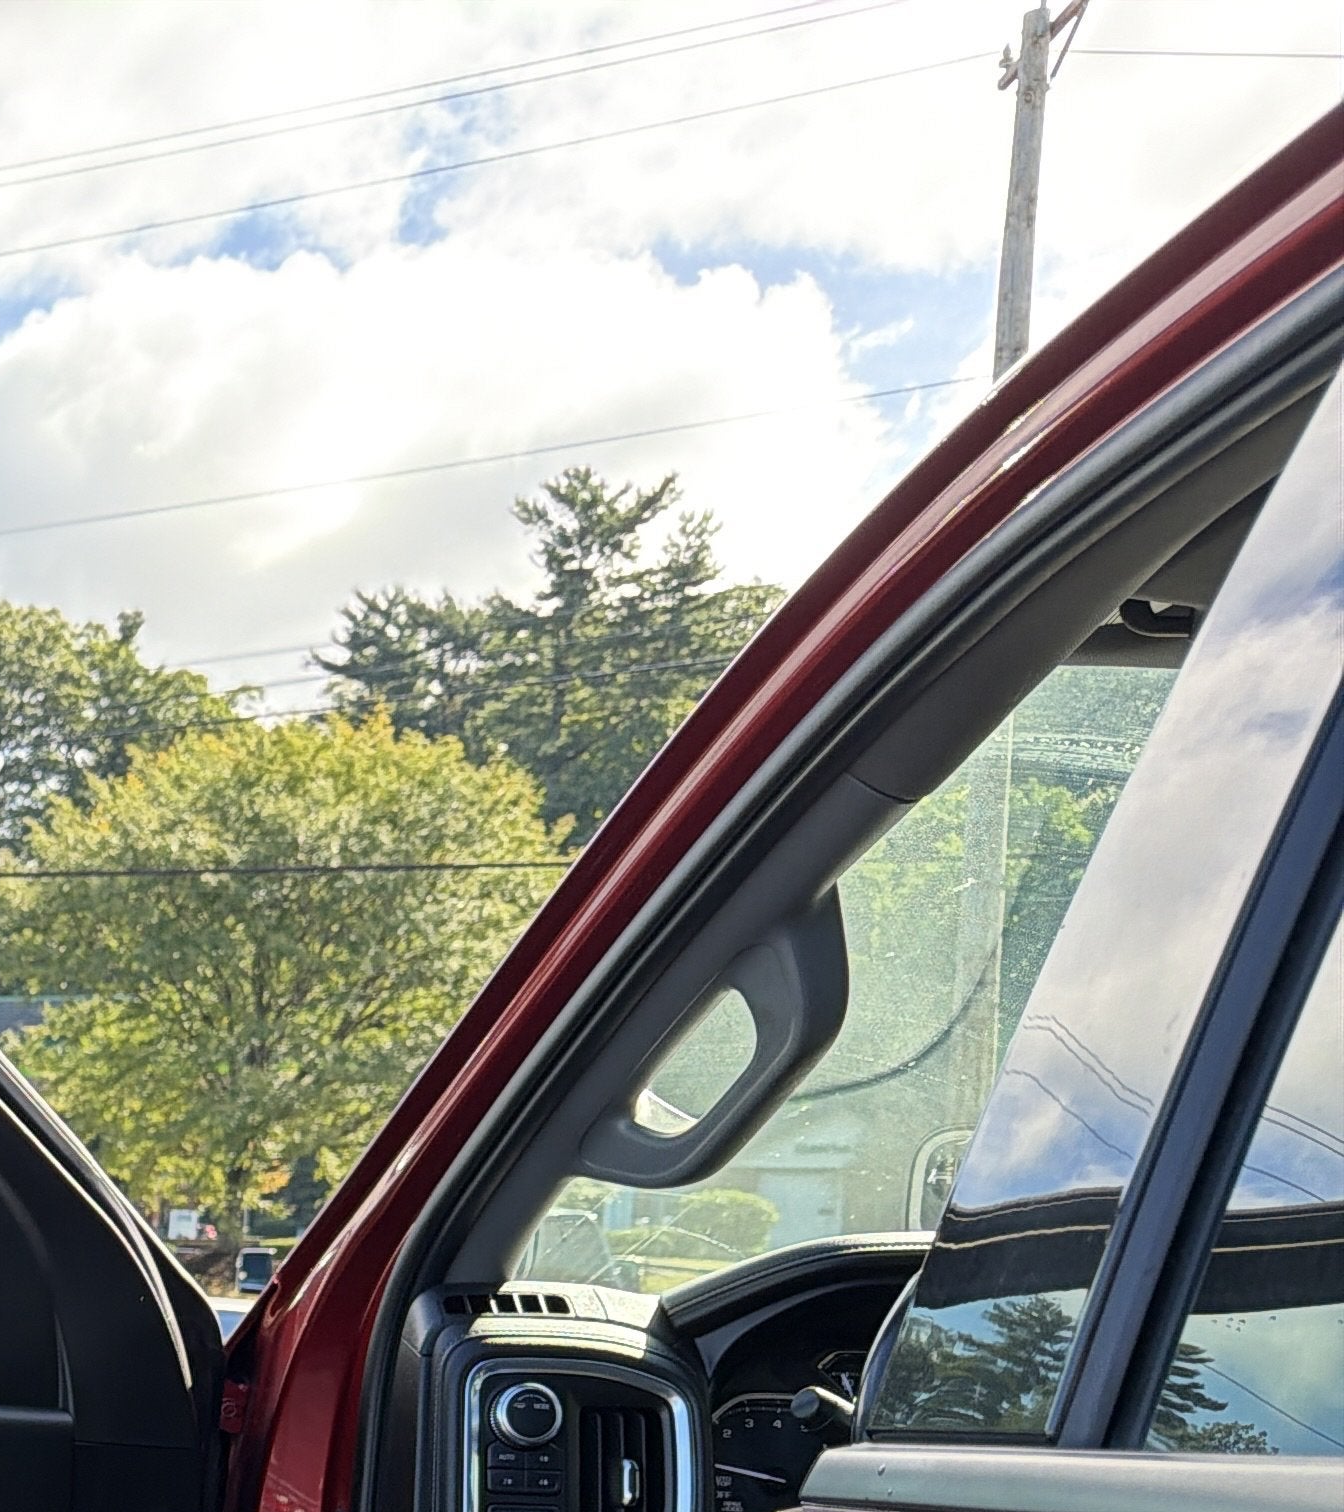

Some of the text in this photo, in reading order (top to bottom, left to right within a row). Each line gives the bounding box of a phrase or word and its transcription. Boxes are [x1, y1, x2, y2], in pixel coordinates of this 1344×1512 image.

[744, 1419, 754, 1429] 3
[773, 1419, 783, 1429] 4
[722, 1428, 733, 1439] 2
